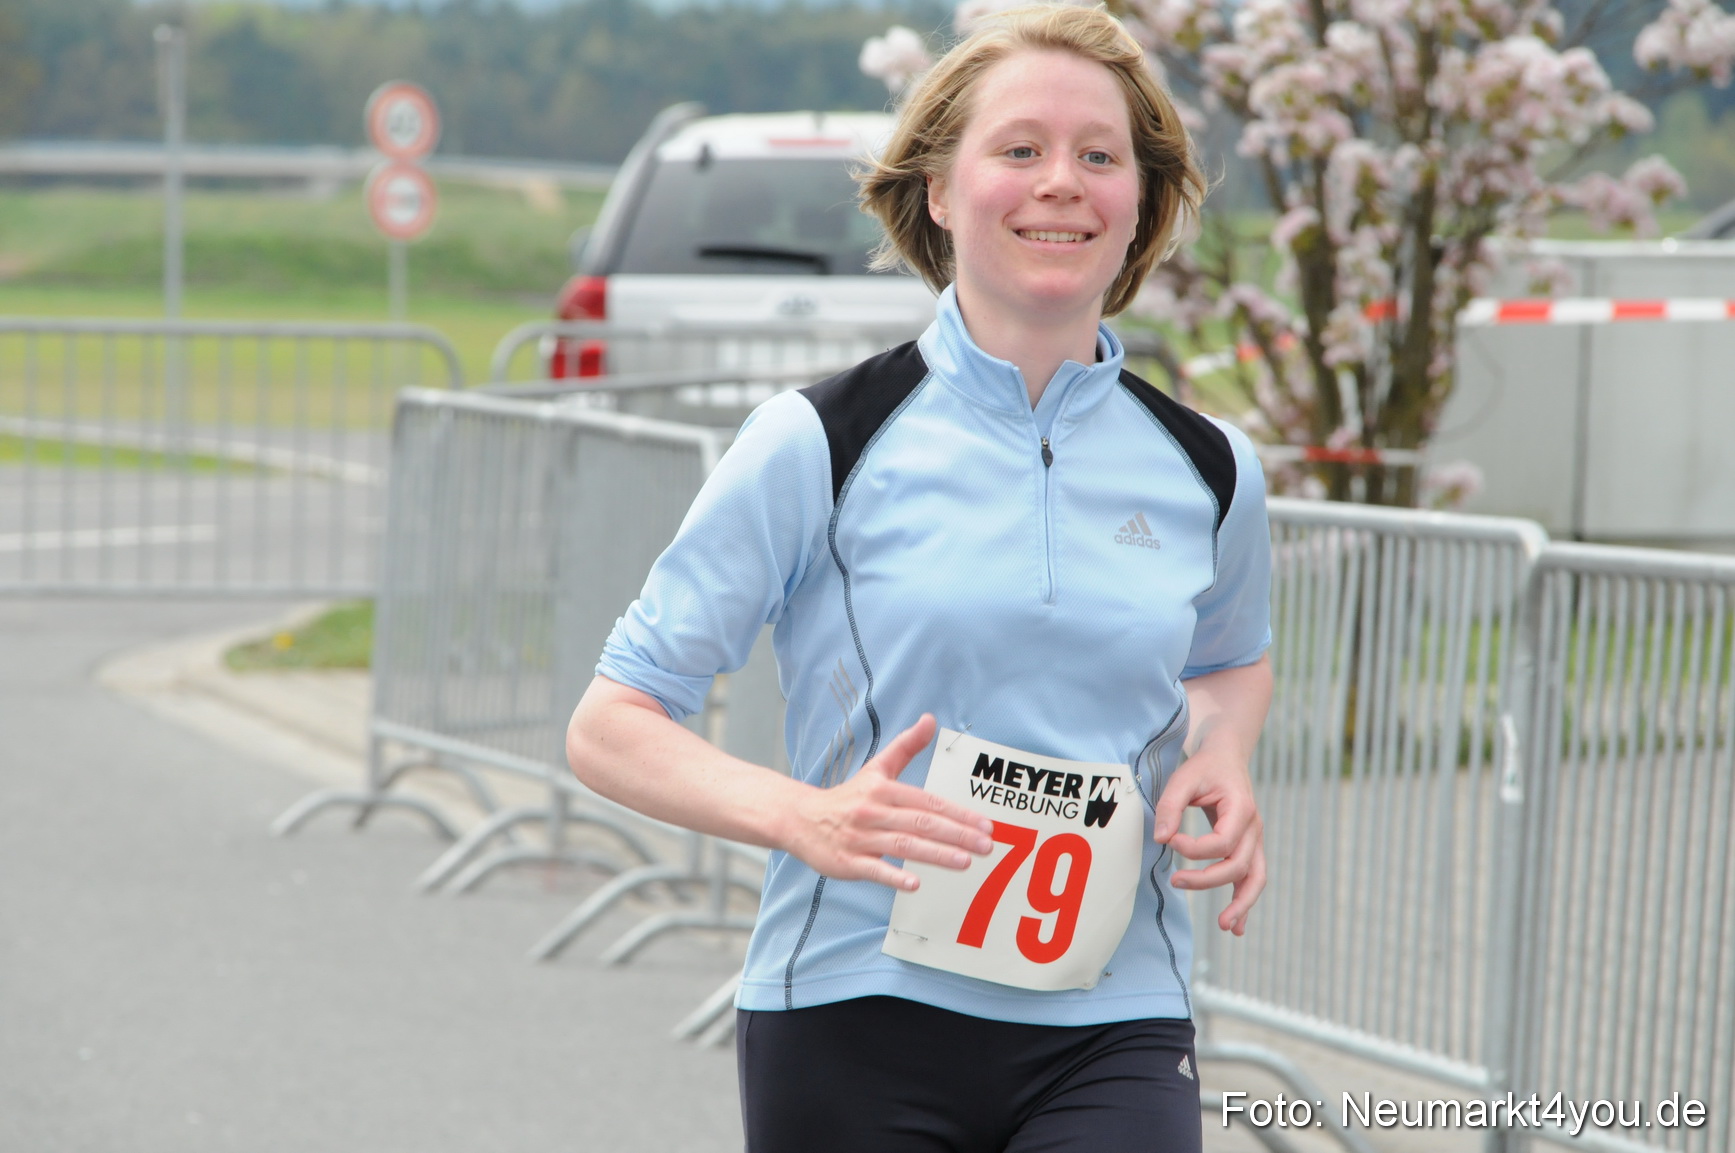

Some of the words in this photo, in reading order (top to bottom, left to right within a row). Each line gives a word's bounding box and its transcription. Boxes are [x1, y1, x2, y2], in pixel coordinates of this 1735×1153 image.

[1114, 533, 1161, 550] adidas
[971, 752, 1084, 799] MEYER
[970, 779, 1079, 819] WERBUNG
[956, 820, 1092, 964] 79
